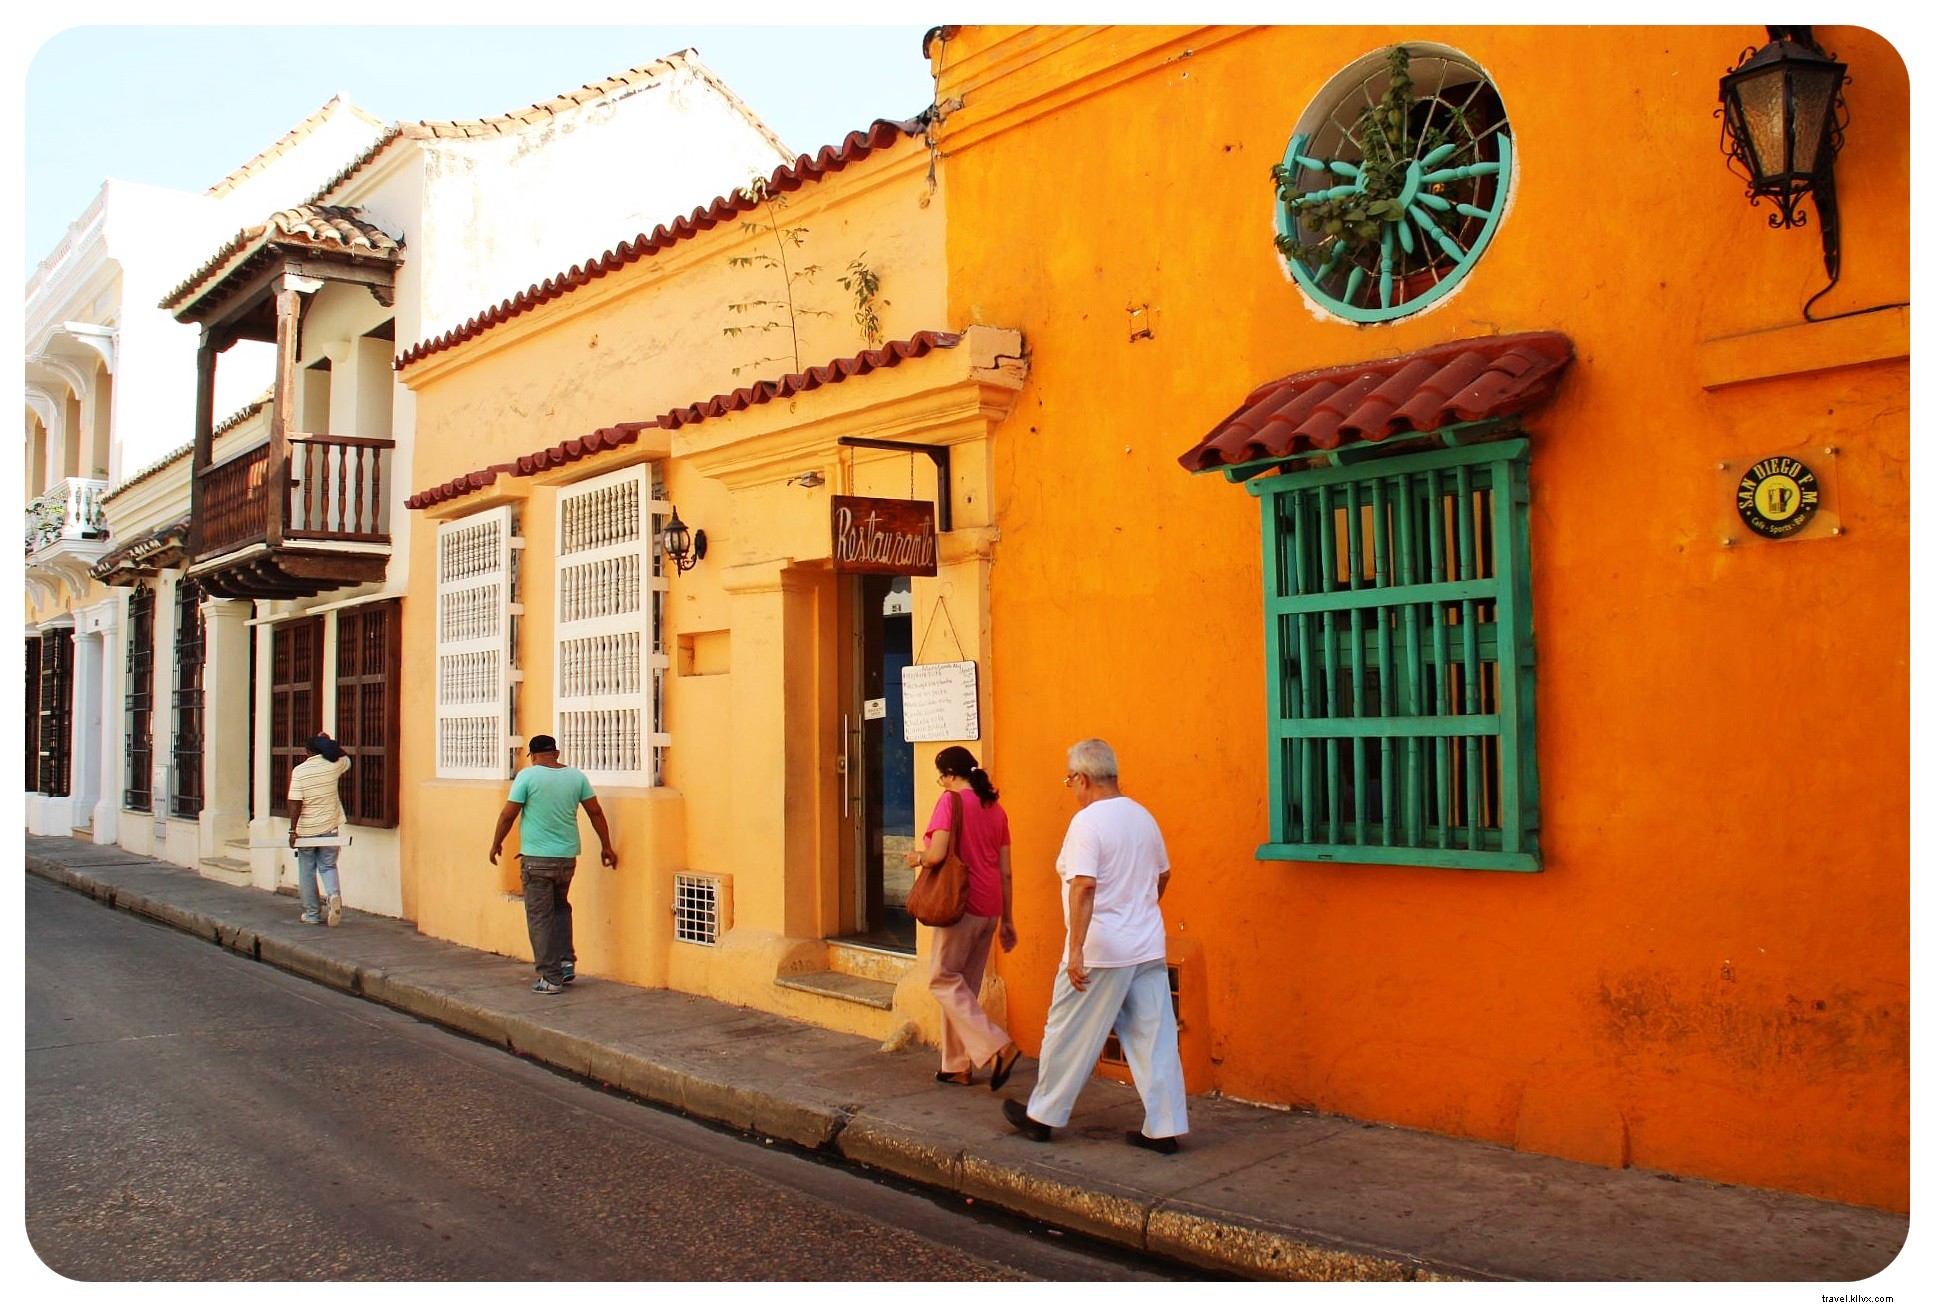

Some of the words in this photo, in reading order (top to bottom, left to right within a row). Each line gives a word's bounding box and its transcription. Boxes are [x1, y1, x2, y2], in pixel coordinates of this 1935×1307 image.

[1738, 478, 1757, 509] SAN
[1753, 458, 1802, 479] DIEGO
[835, 506, 934, 568] Restaurante
